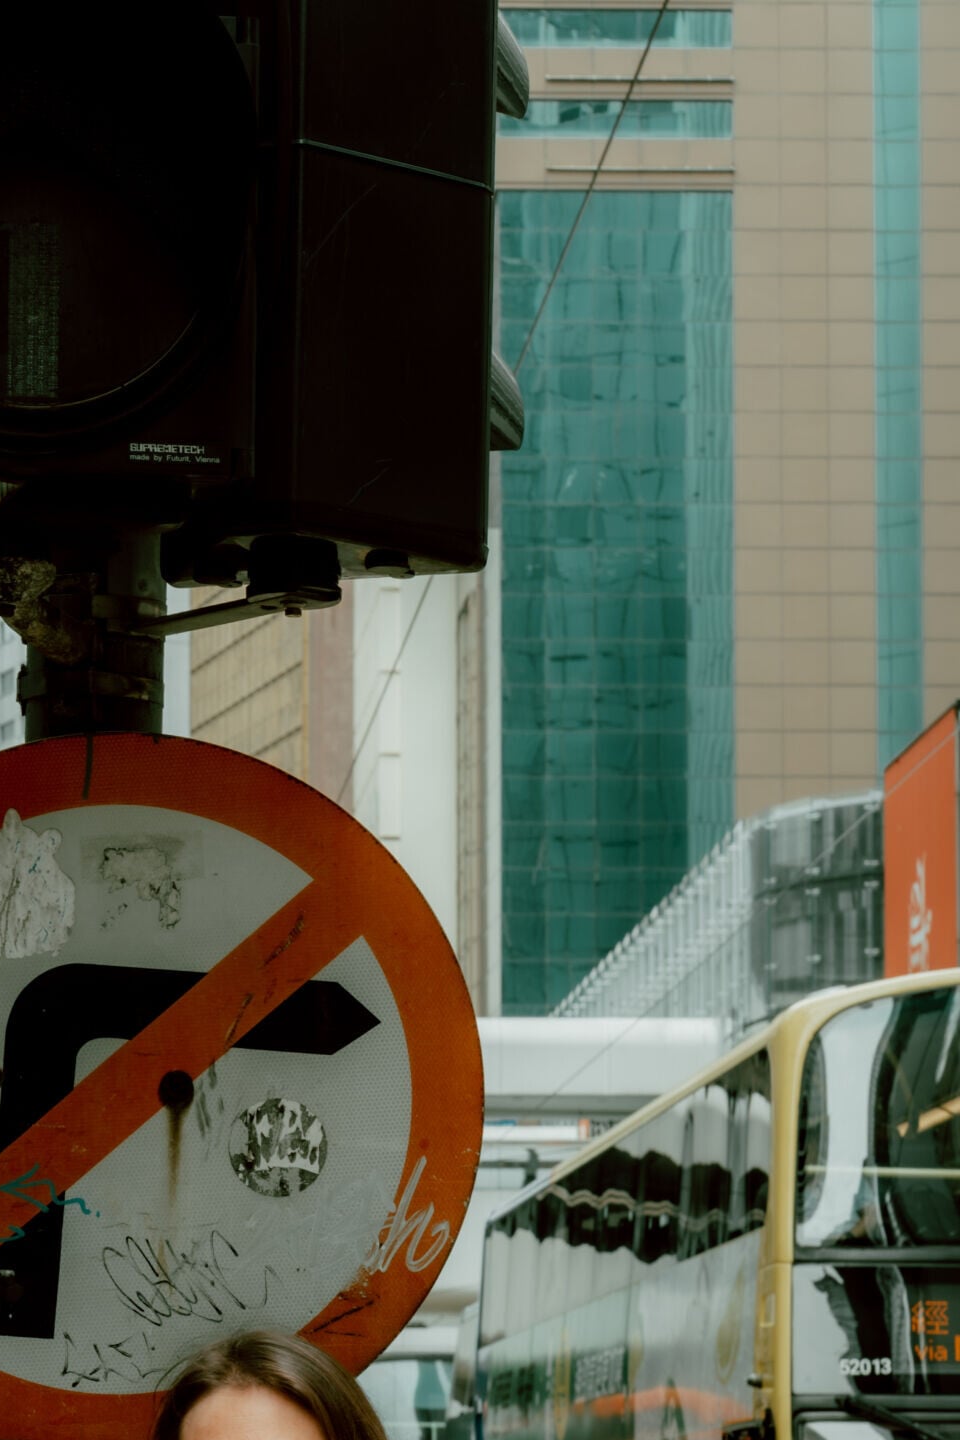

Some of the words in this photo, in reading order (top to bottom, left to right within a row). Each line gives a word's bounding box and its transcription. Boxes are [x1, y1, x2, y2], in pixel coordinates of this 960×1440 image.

[129, 443, 205, 454] SUPREMETECH
[129, 453, 150, 461] made
[153, 454, 163, 463] by
[914, 1338, 949, 1362] via
[839, 1357, 892, 1376] 52013
